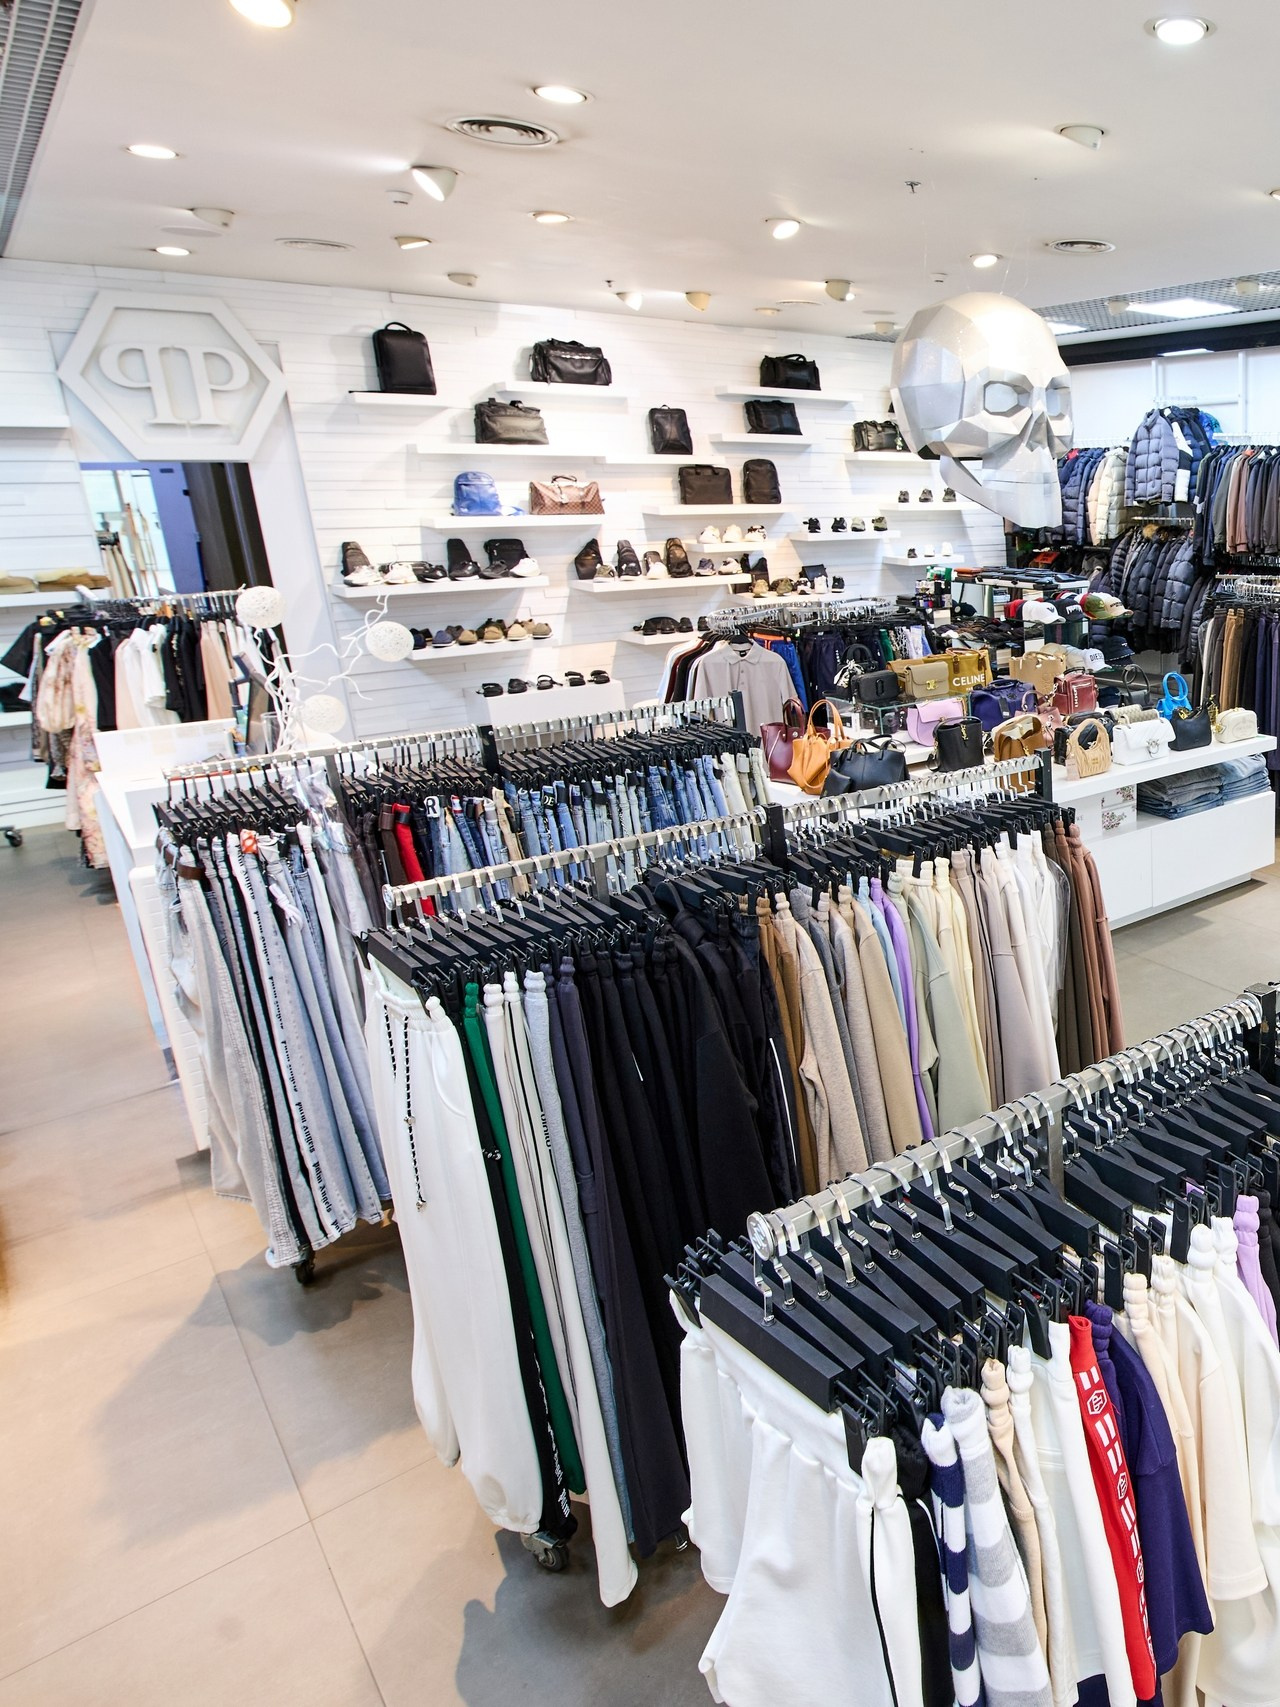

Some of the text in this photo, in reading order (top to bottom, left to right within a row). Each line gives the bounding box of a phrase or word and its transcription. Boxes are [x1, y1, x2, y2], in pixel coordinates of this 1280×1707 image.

[953, 674, 985, 687] CELINE
[312, 1161, 332, 1213] Palm Angels
